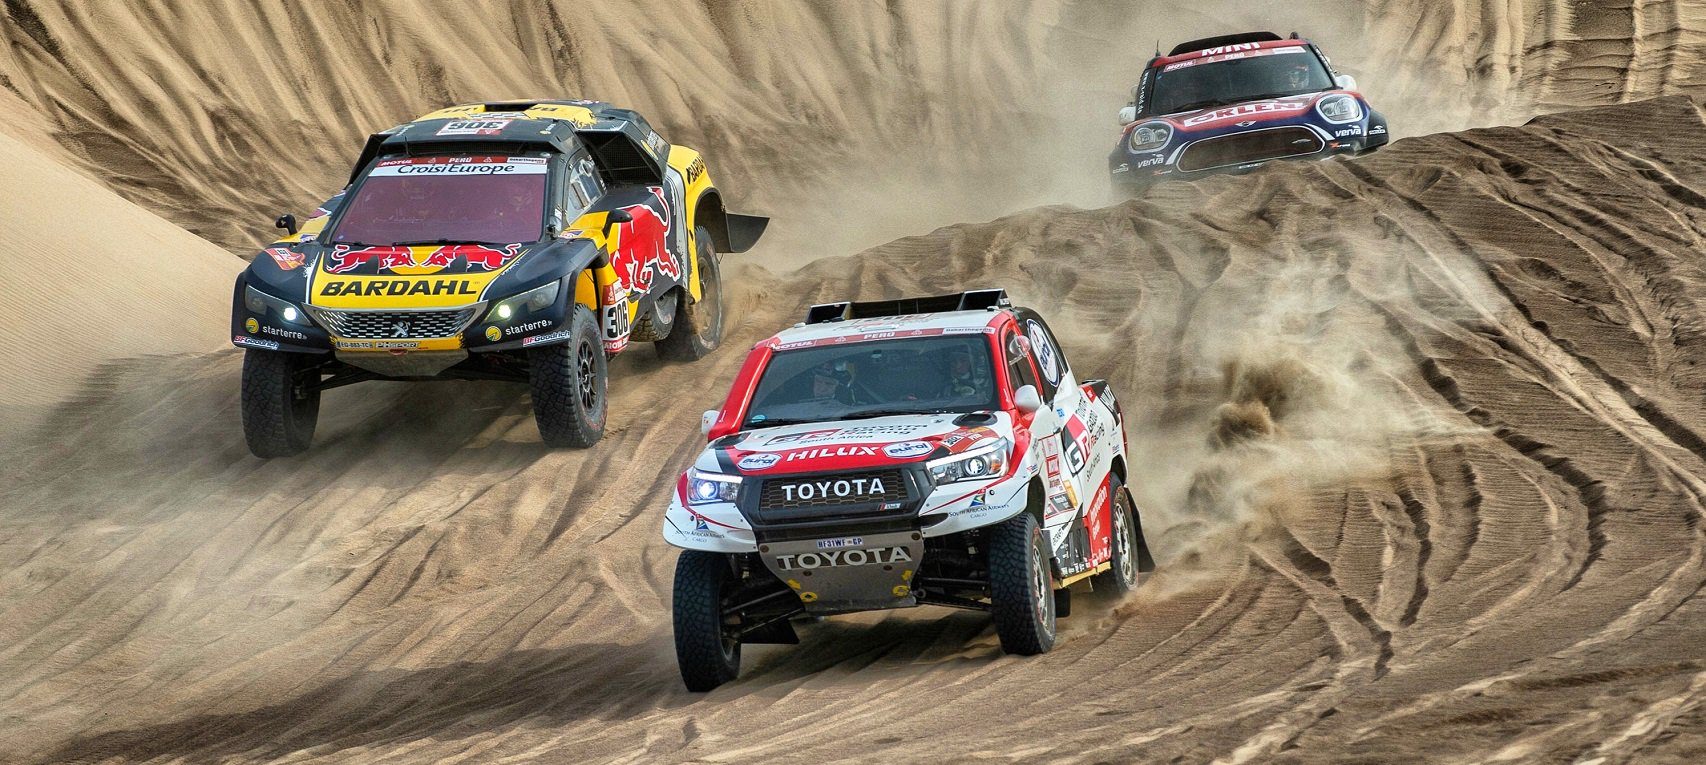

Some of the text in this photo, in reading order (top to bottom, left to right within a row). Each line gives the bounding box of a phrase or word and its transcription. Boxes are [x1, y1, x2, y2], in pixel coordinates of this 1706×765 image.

[1201, 42, 1260, 56] MINI
[1335, 128, 1362, 137] verva
[397, 163, 515, 175] CroisiEurope
[1137, 157, 1165, 168] verva
[321, 280, 477, 296] BARDAHL
[607, 301, 629, 339] 306
[234, 335, 279, 350] BFGoodrich
[523, 330, 571, 346] BFGoodrich
[786, 446, 881, 462] HILUX
[889, 442, 929, 455] eurol
[742, 456, 776, 467] eurol
[781, 477, 886, 501] TOYOTA
[776, 547, 913, 571] TOYOTA
